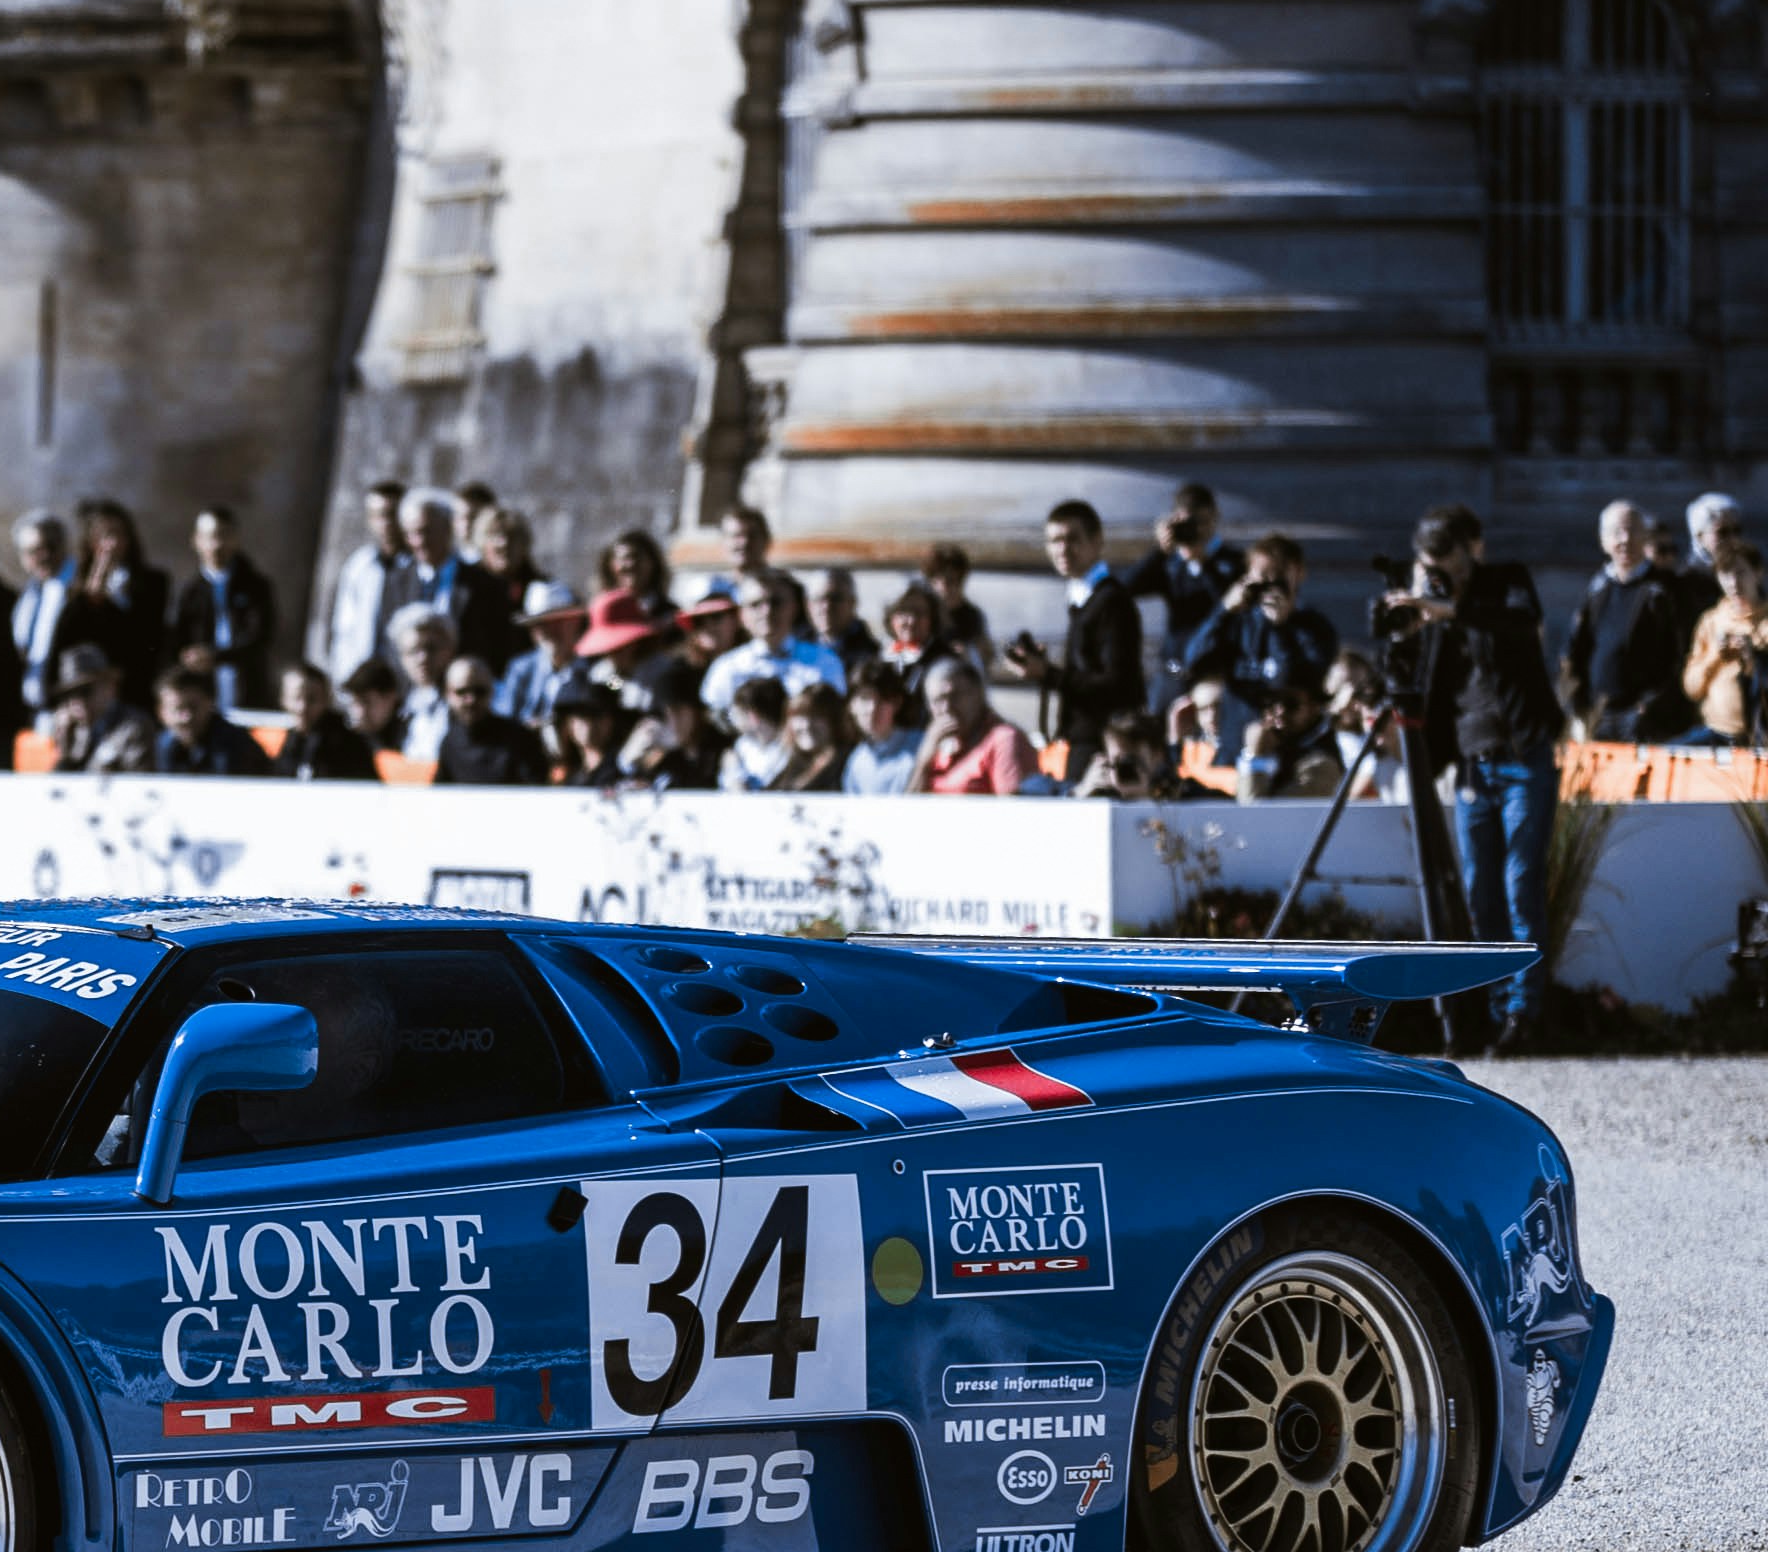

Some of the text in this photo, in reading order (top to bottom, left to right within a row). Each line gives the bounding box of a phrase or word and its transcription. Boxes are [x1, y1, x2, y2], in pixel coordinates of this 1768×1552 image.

[946, 1182, 1086, 1222] MONTE
[949, 1214, 1088, 1256] CARLO
[960, 1258, 1080, 1274] TMC
[153, 1184, 820, 1416] MONTE 34
[1153, 1226, 1255, 1406] MICHELIN
[161, 1293, 496, 1388] CARLO
[954, 1372, 1094, 1394] presse informatique
[179, 1396, 469, 1431] TMC
[944, 1413, 1107, 1443] MICHELIN
[135, 1468, 253, 1508] RETRO
[430, 1452, 573, 1534] JVC
[632, 1449, 815, 1535] BBS
[1067, 1468, 1111, 1482] KONI
[165, 1507, 297, 1550] MOBILE
